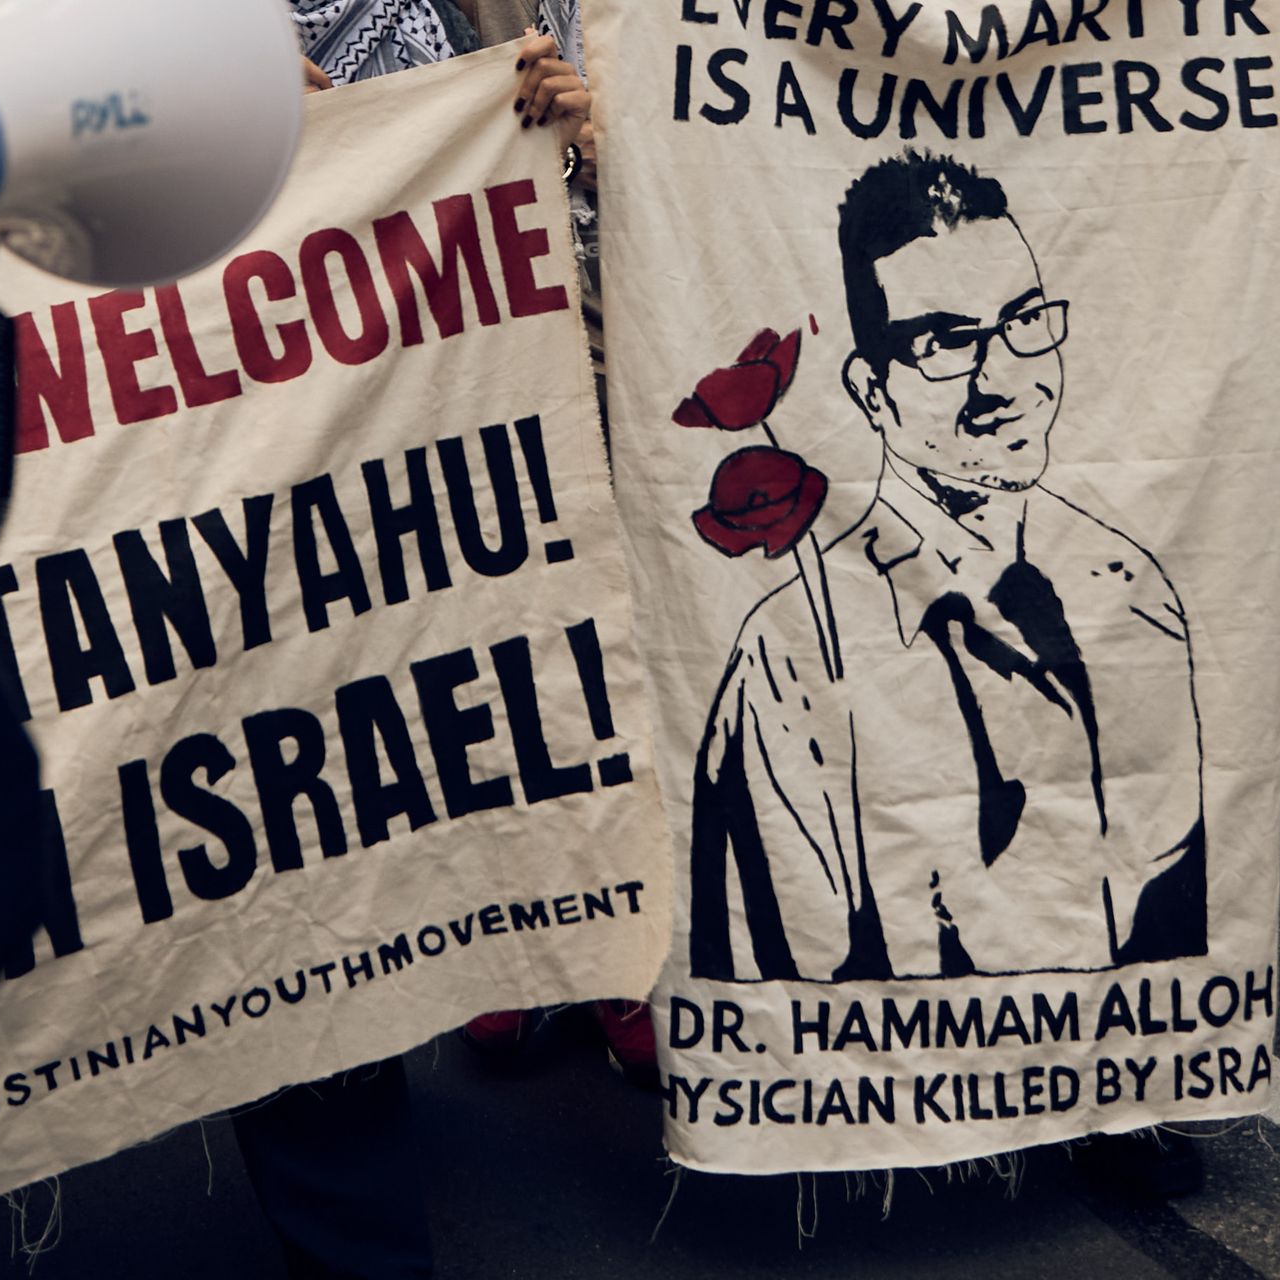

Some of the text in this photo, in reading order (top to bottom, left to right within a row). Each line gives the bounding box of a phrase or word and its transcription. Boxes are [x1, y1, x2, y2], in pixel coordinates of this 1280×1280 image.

[673, 44, 1278, 140] IS A UNIVERSE
[117, 617, 633, 925] ISRAEL!
[669, 965, 1275, 1055] DR. HAMMAM ALLOH
[660, 1043, 1273, 1126] HYSICIAN KILLED BY ISRA
